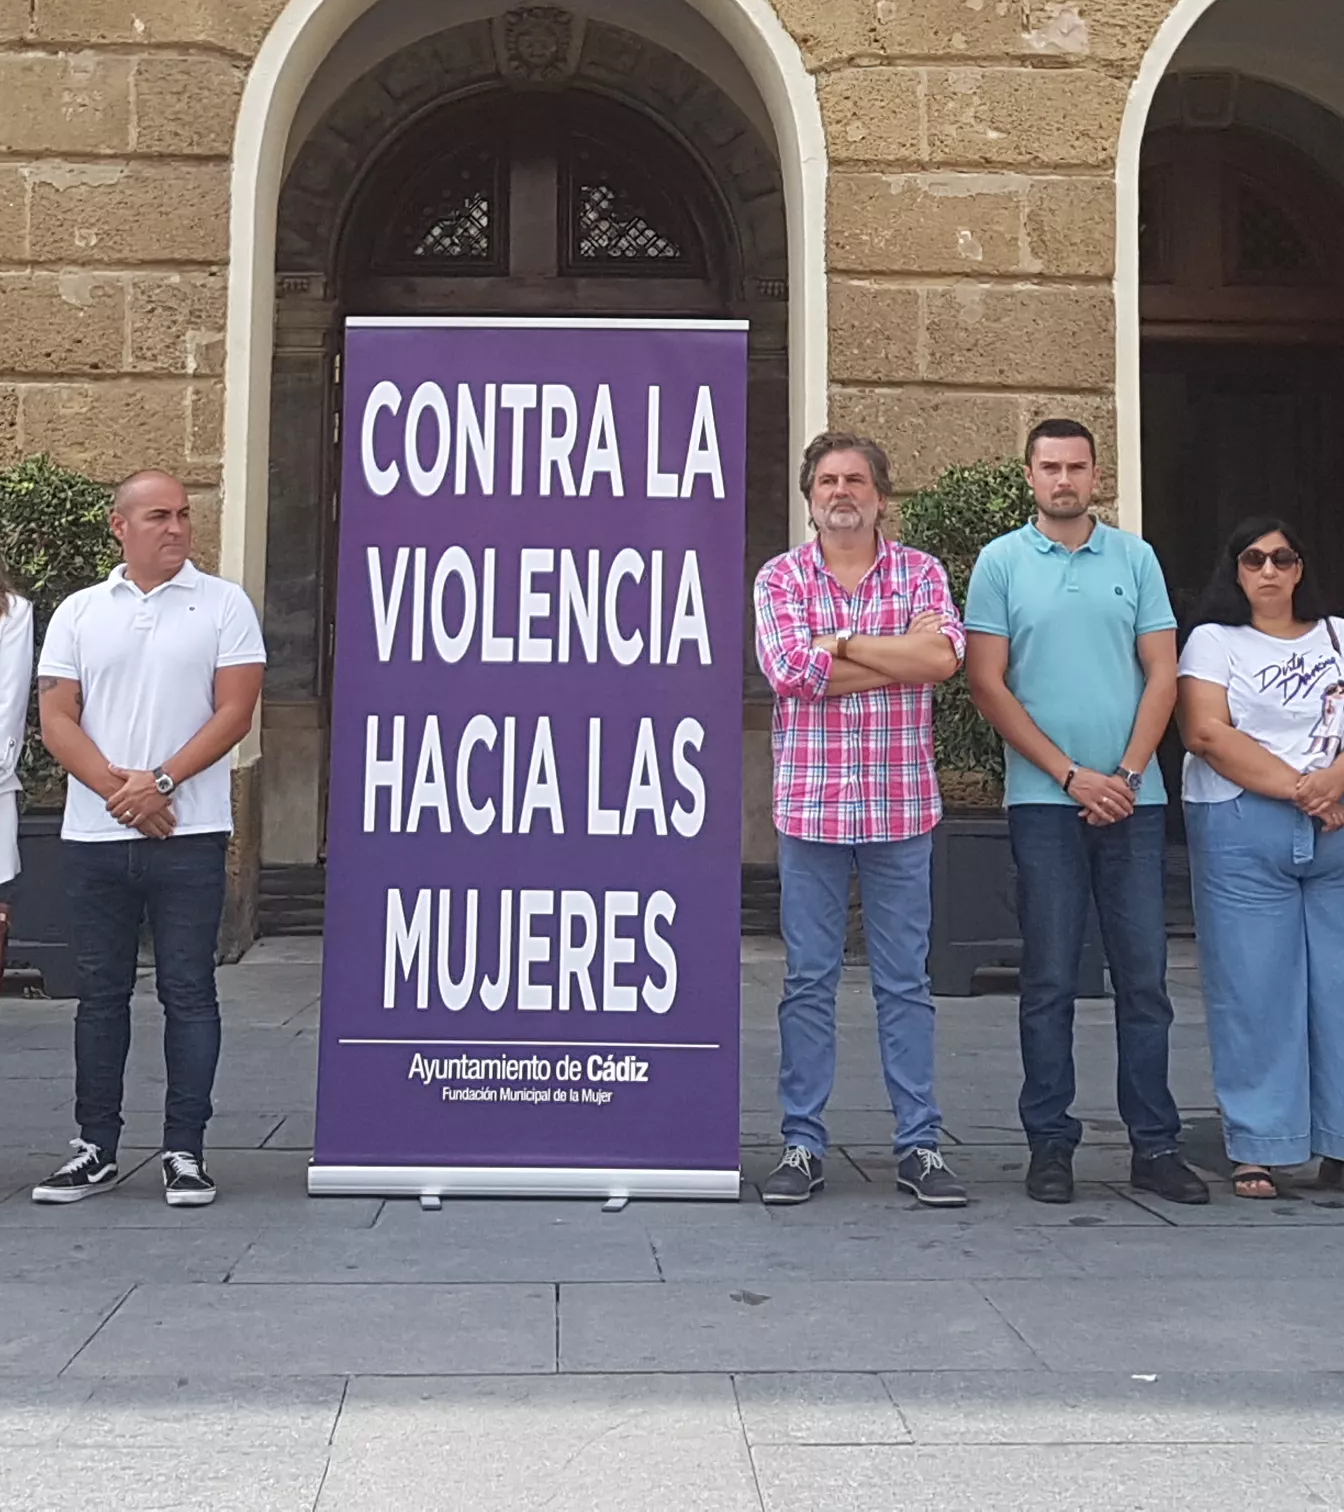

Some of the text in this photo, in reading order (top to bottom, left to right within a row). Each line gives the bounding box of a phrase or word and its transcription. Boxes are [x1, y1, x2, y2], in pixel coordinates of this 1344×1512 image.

[361, 380, 725, 499] CONTRA LA
[367, 545, 712, 665] VIOLENCIA
[1253, 649, 1313, 693] Dirty
[363, 714, 706, 838] HACIA LAS
[383, 888, 678, 1014] MUJERES
[408, 1053, 649, 1084] Ayuntamiento de Cádiz
[442, 1086, 613, 1105] Fundación Municipal de la Mujer
